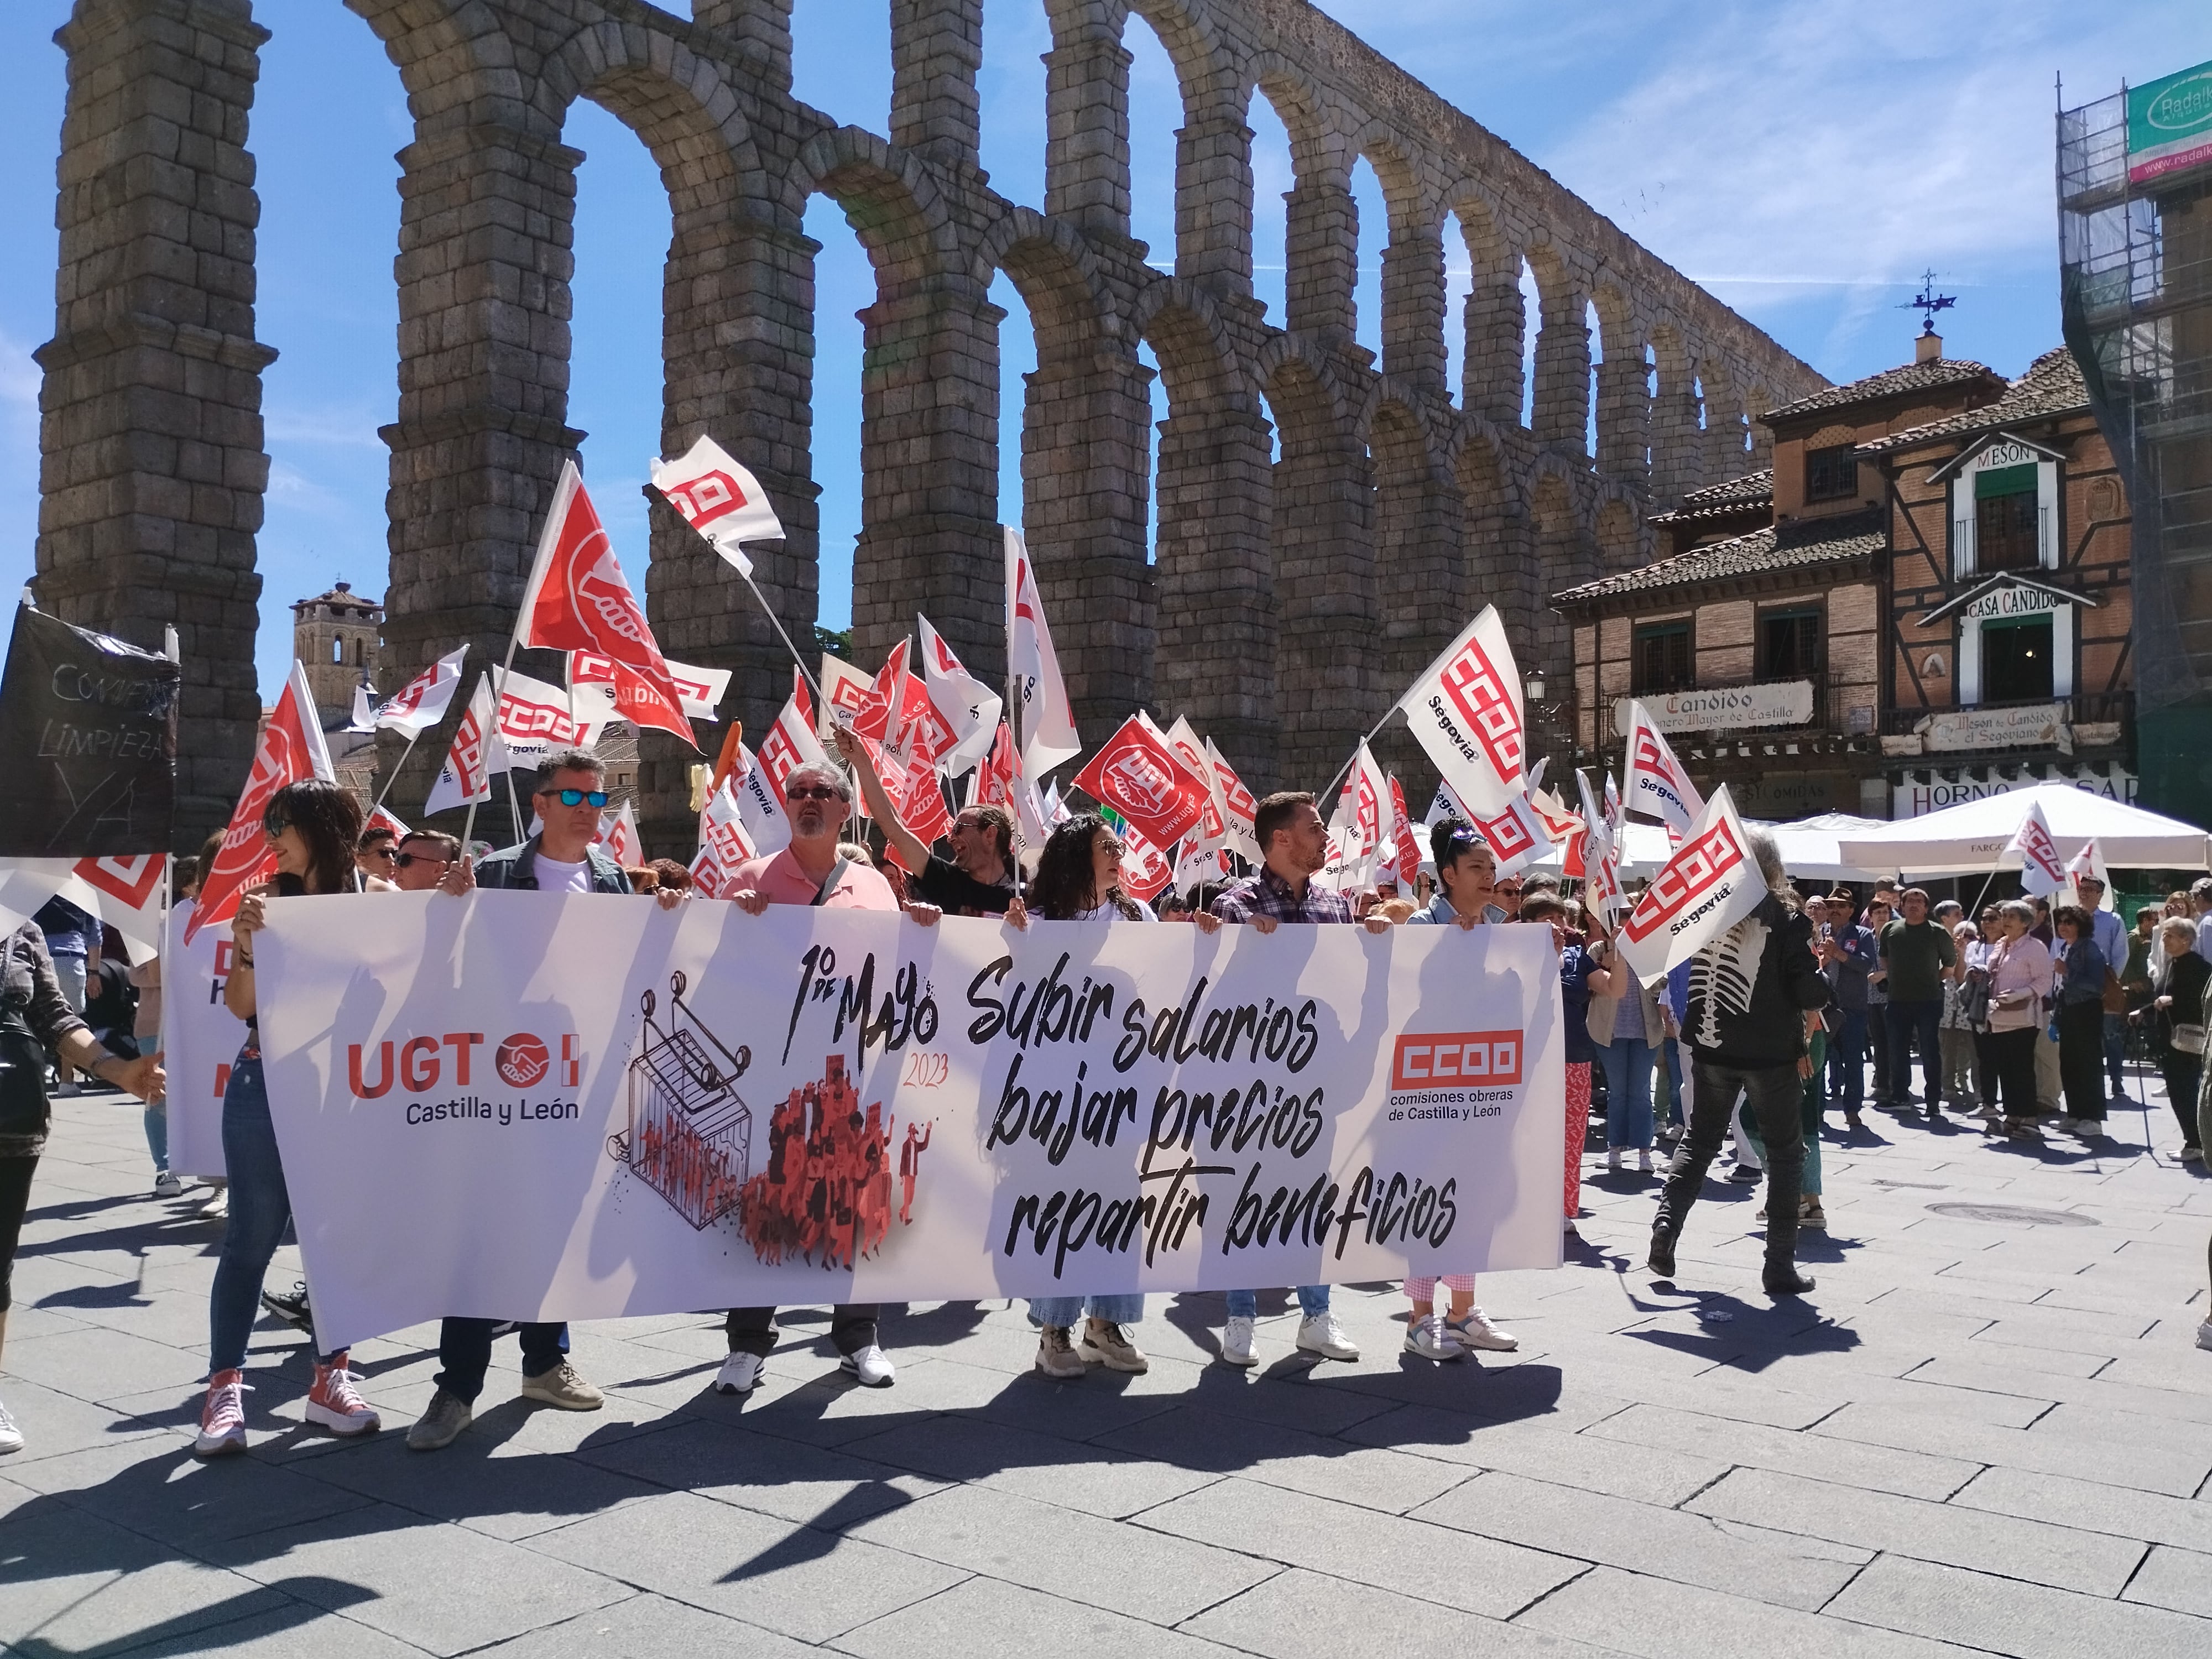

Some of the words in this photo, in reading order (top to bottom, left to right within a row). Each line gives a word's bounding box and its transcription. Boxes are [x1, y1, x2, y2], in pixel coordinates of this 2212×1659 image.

[1978, 445, 2030, 468] MESON
[1969, 595, 2000, 618] CASA
[2002, 590, 2059, 613] CANDIDO
[1448, 648, 1521, 770] CCOO
[1666, 692, 1752, 714] Candido
[1686, 713, 1724, 727] Mayor
[1730, 712, 1742, 722] de
[1748, 706, 1794, 719] Castilla
[2007, 711, 2053, 726] Candido
[1428, 696, 1475, 761] Segovia
[1965, 732, 1974, 743] el
[1979, 730, 2039, 744] Segoviano
[45, 760, 137, 849] YA
[1640, 778, 1689, 818] Segovia
[1631, 830, 1735, 929] CCOO
[1670, 888, 1731, 936] Segovia
[812, 978, 837, 1003] DE
[967, 952, 1114, 1051] Subir
[1112, 976, 1318, 1073] salarios
[348, 1032, 484, 1099] UGT
[903, 1052, 950, 1089] 2023
[1402, 1041, 1516, 1079] CCOO
[406, 1096, 492, 1125] Castilla
[498, 1102, 512, 1126] y
[520, 1097, 579, 1120] León
[986, 1052, 1138, 1166] bajar
[1139, 1079, 1324, 1175] precios
[1389, 1109, 1404, 1121] de
[1408, 1107, 1458, 1120] Castilla
[1463, 1108, 1470, 1121] y
[1473, 1104, 1501, 1118] León
[1390, 1091, 1465, 1105] comisiones
[1469, 1089, 1513, 1102] obreras
[1005, 1157, 1236, 1280] repartir
[1222, 1161, 1457, 1260] beneficios
